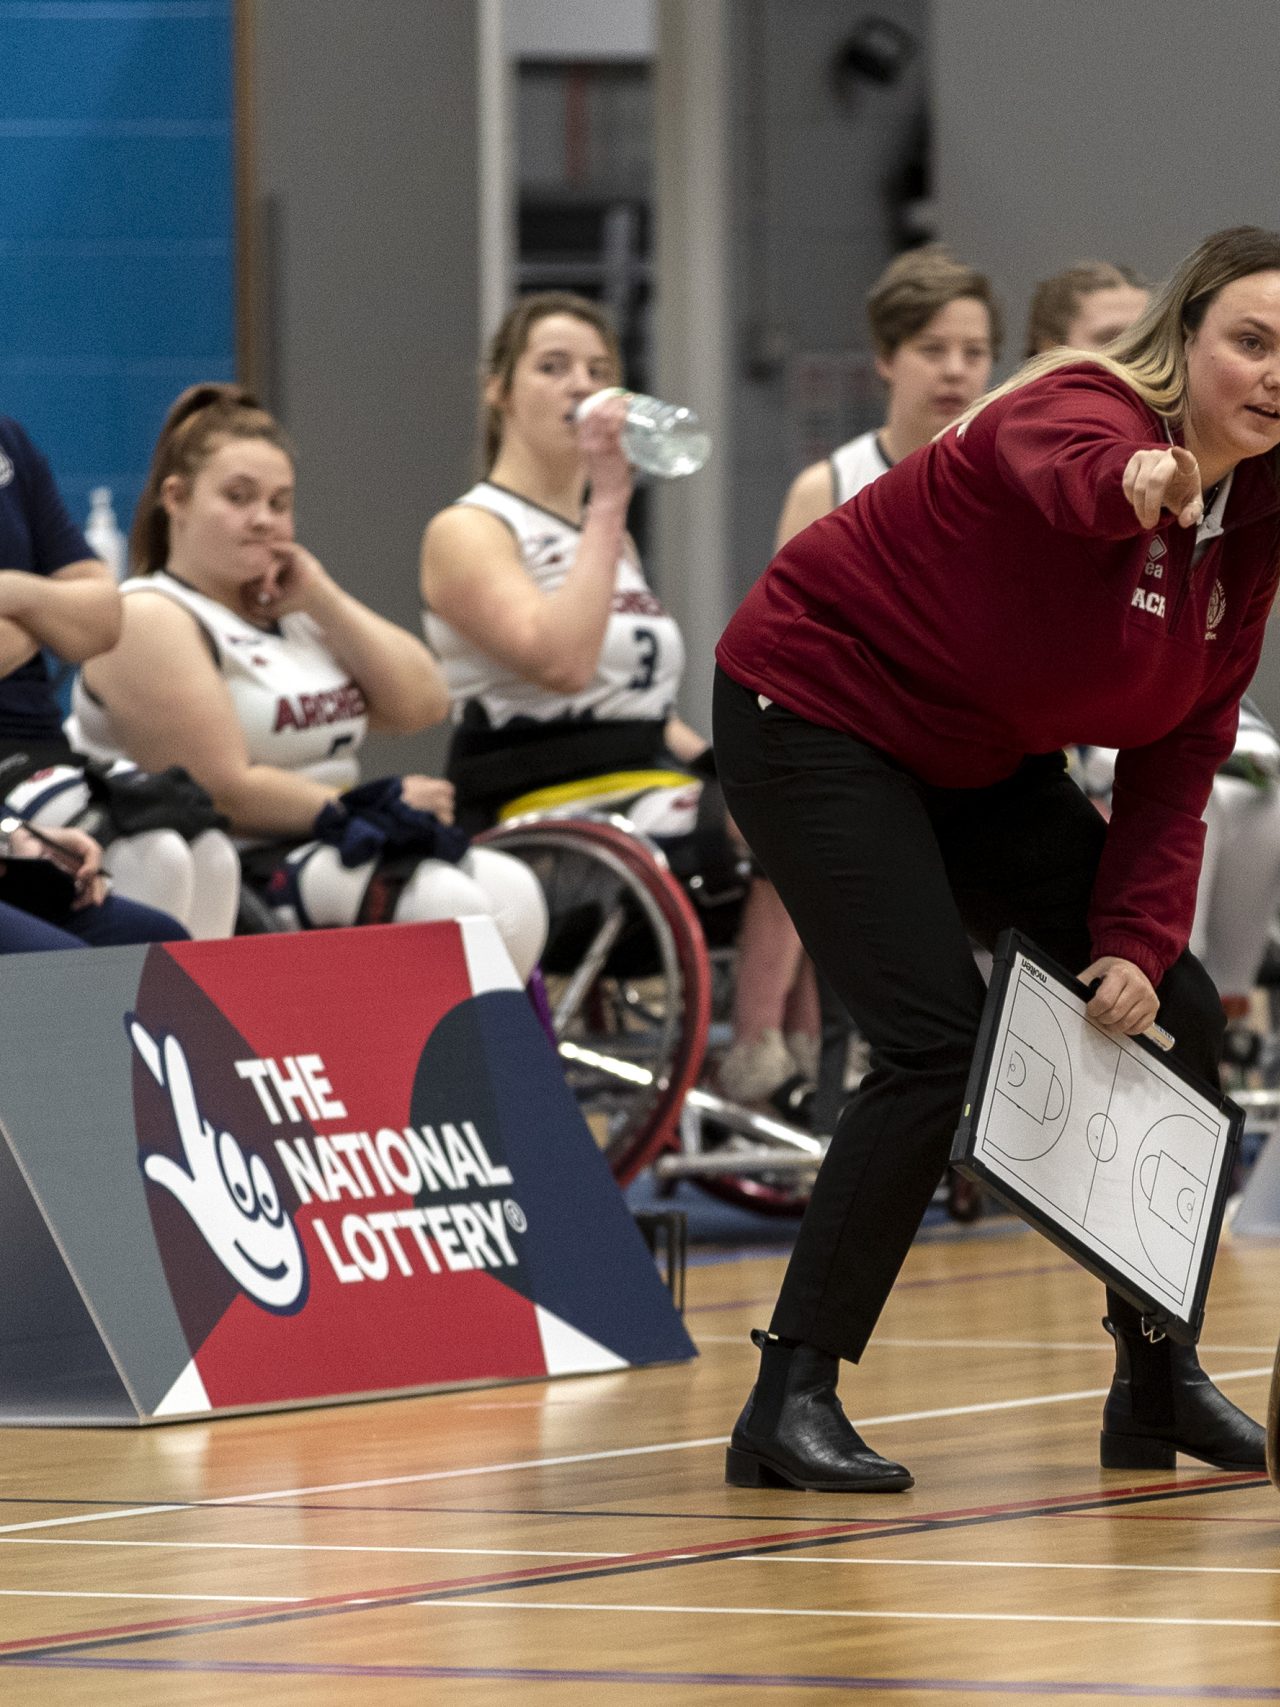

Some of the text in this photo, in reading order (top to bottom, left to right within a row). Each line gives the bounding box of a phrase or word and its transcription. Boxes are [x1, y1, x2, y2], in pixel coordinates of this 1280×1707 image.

[1130, 586, 1167, 619] ACH
[626, 627, 658, 690] 3
[272, 686, 367, 734] ARCHE
[1021, 958, 1048, 984] molten
[233, 1053, 349, 1125] THE
[273, 1120, 514, 1205] NATIONAL
